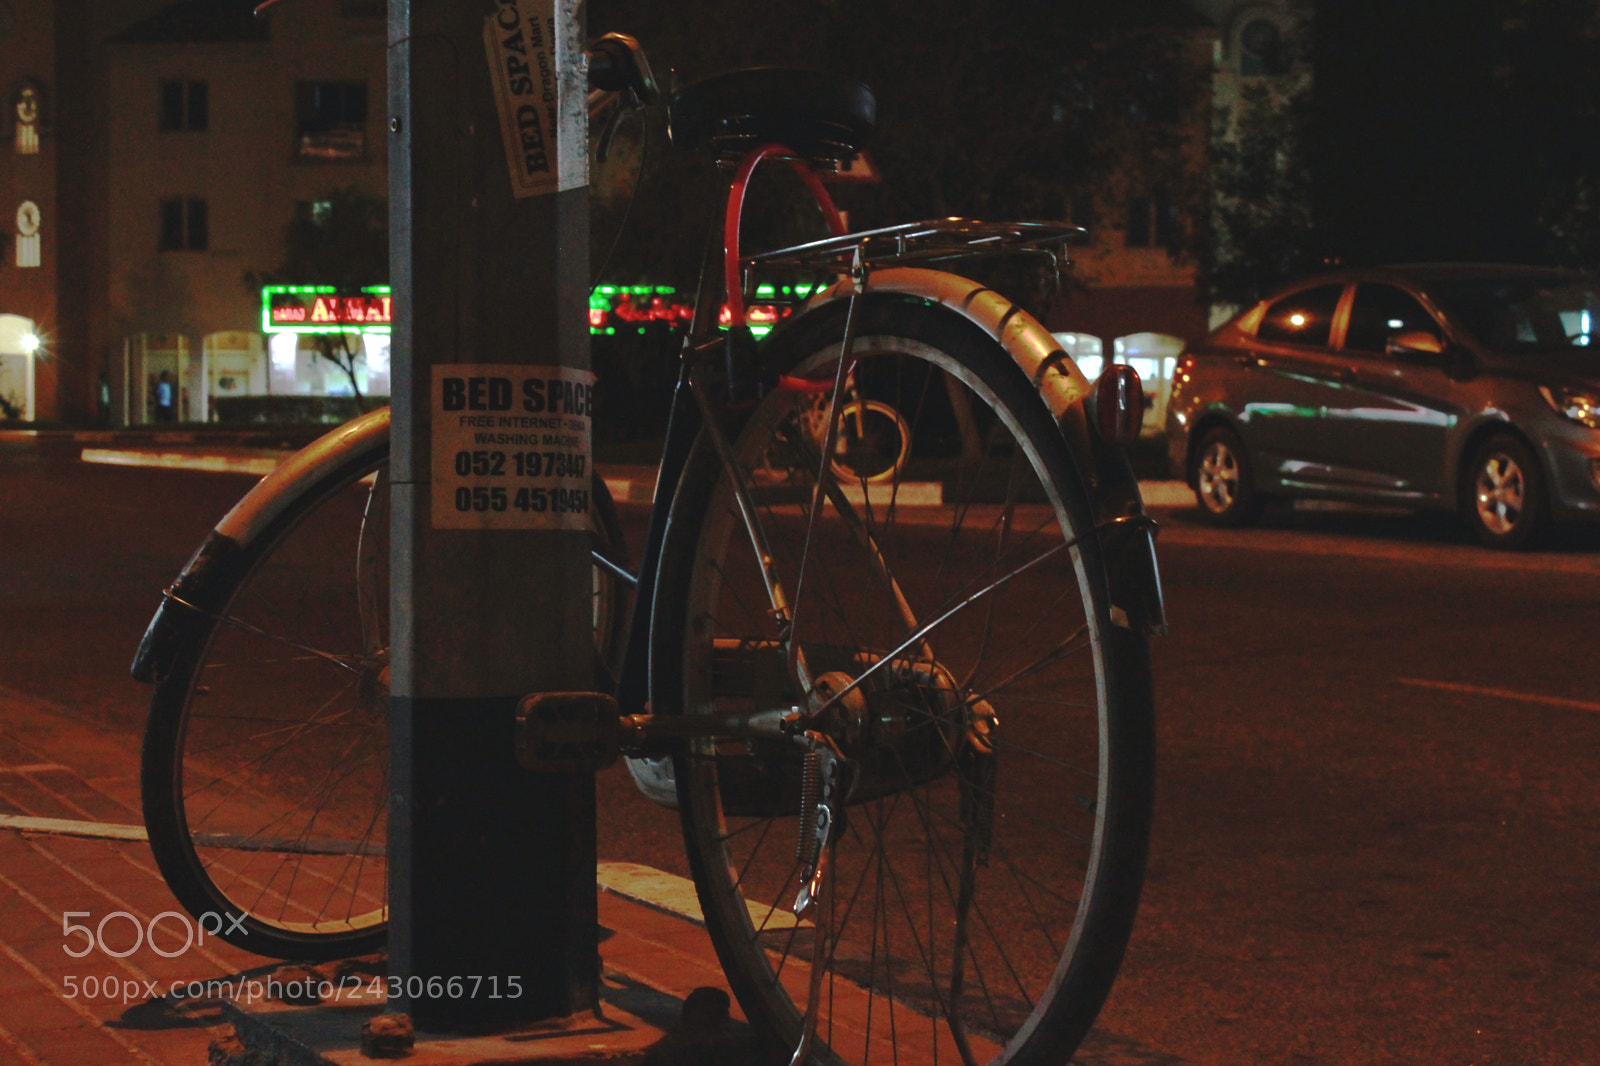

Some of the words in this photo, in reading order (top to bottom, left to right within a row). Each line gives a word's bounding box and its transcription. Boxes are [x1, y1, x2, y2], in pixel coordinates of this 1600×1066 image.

[497, 0, 534, 96] SPAC
[528, 16, 544, 48] Mart
[537, 52, 554, 102] Dragon
[517, 105, 550, 175] BED
[442, 377, 513, 412] BED
[459, 415, 495, 428] FREE
[474, 433, 539, 446] WASHING
[455, 451, 506, 476] 052
[512, 451, 586, 478] 1973447
[455, 486, 508, 512] 055
